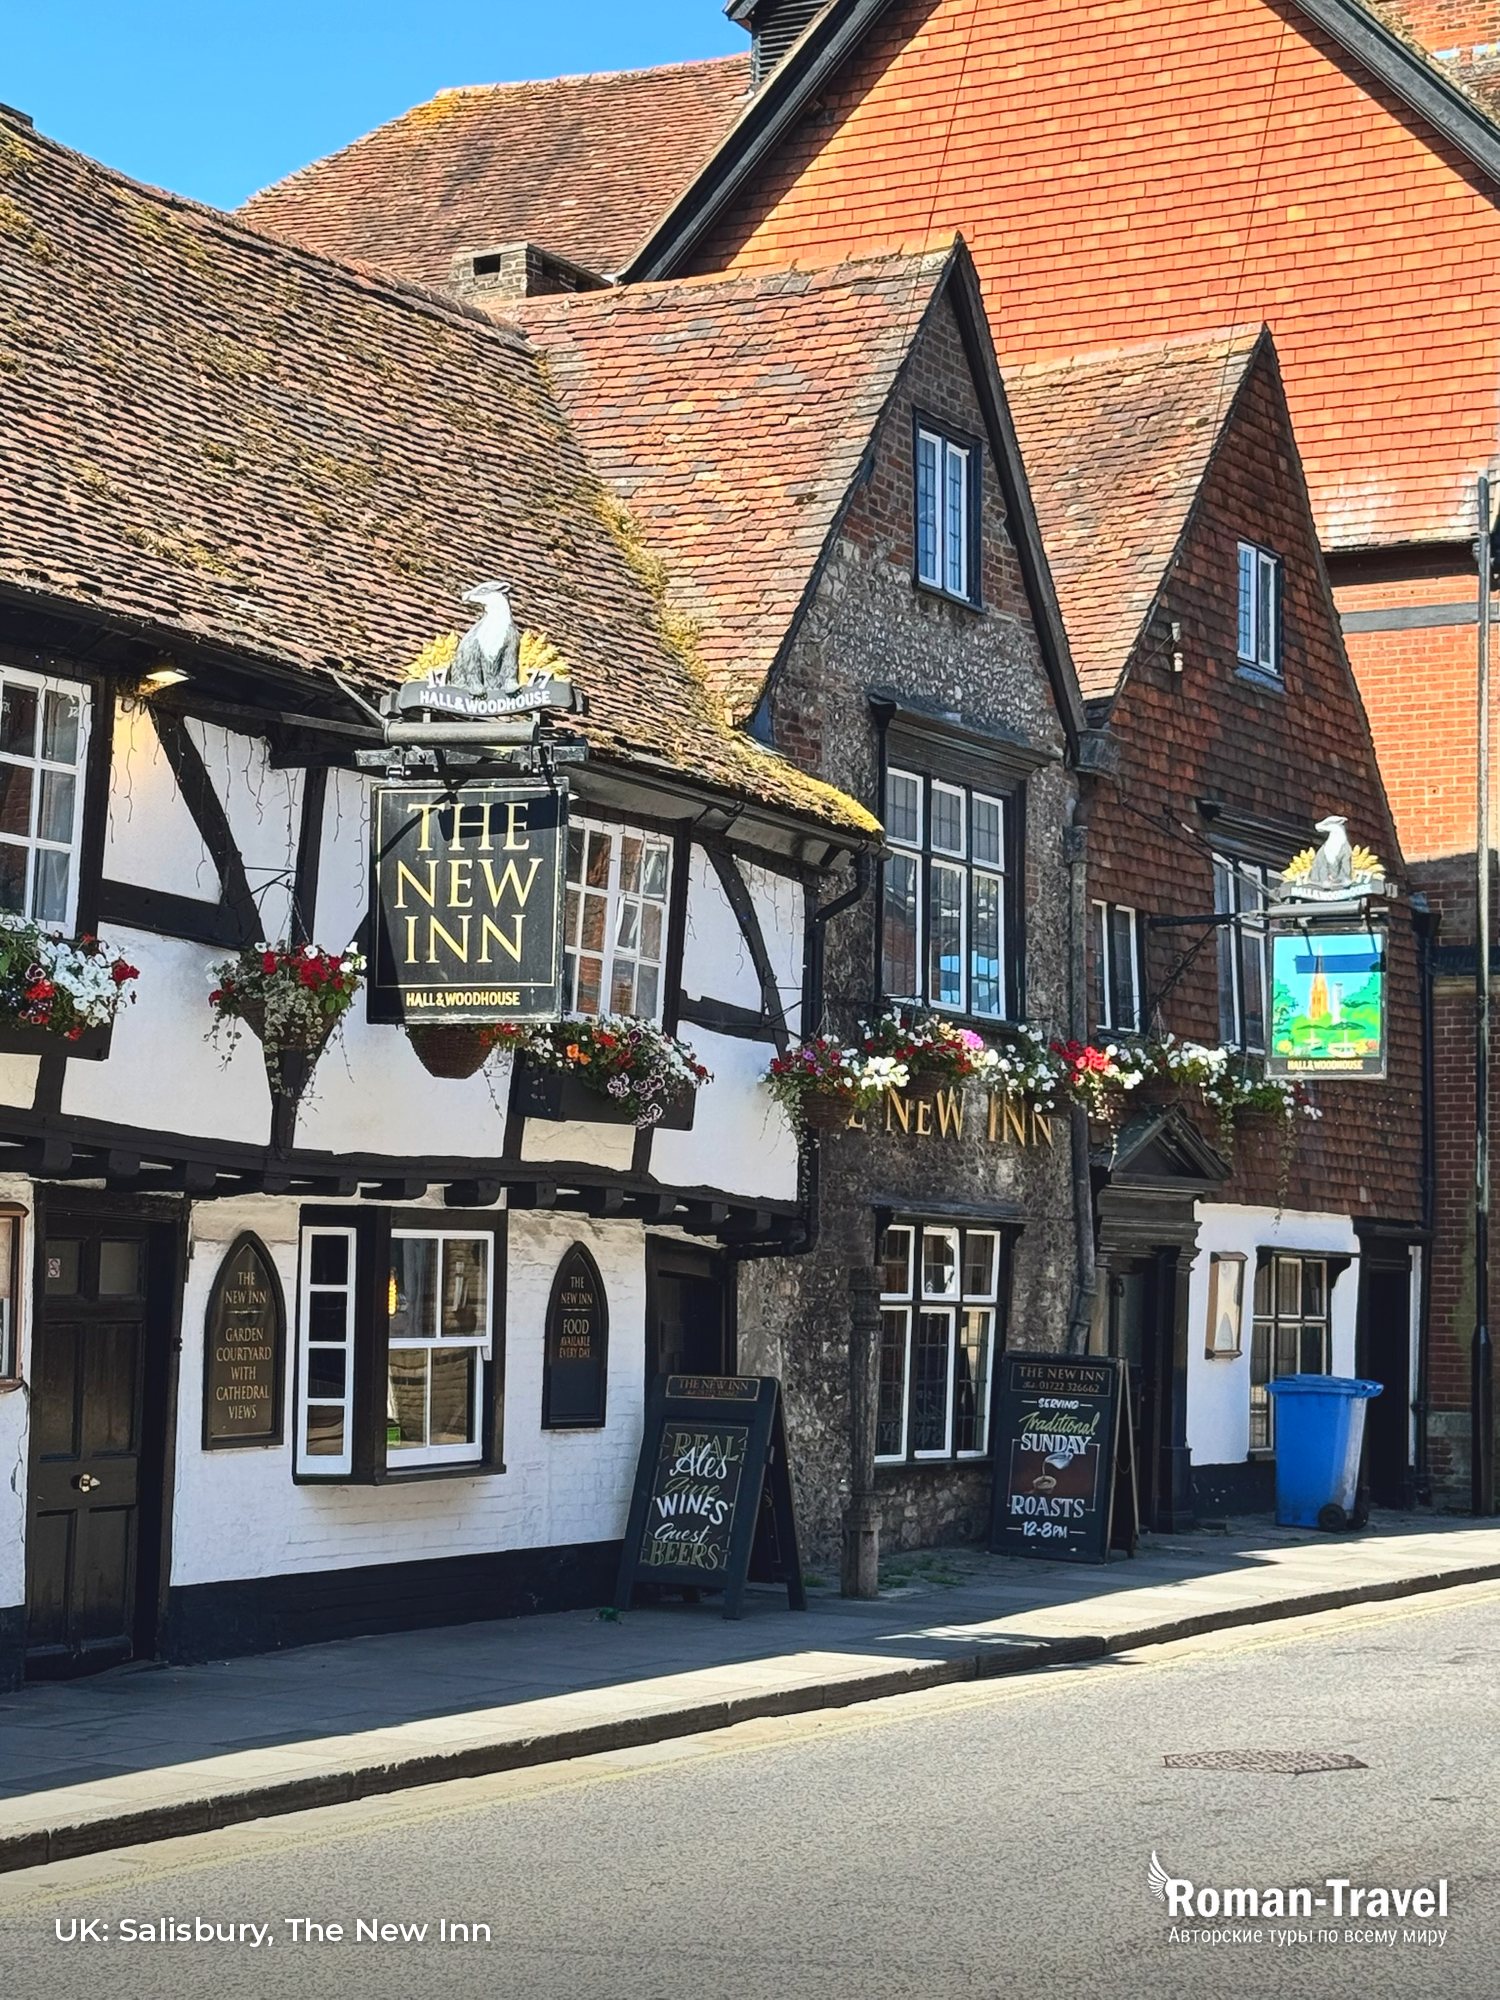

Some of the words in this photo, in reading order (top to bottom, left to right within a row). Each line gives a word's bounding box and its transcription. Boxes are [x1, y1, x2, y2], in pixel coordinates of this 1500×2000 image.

[426, 669, 446, 689] 17
[407, 802, 530, 852] THE
[394, 857, 543, 909] NEW
[403, 914, 526, 964] INN
[238, 1272, 255, 1286] THE
[570, 1276, 585, 1289] THE
[225, 1291, 247, 1304] NEW
[248, 1290, 266, 1303] INN
[561, 1293, 577, 1304] NEW
[578, 1293, 593, 1304] INN
[225, 1327, 263, 1342] GARDEN
[563, 1319, 590, 1335] FOOD
[216, 1347, 272, 1362] COURTYARD
[230, 1366, 256, 1380] WITH
[1020, 1366, 1044, 1378] THE
[1047, 1368, 1077, 1379] NEW
[1080, 1370, 1105, 1381] INN
[679, 1378, 700, 1389] THE
[701, 1379, 726, 1390] NEW
[728, 1380, 750, 1391] INN
[1039, 1381, 1064, 1391] 01722
[1067, 1383, 1100, 1393] 326662
[216, 1385, 269, 1400] CATHEDRAL
[1038, 1398, 1079, 1409] SERVING
[228, 1404, 257, 1419] VIEWS
[1019, 1412, 1100, 1436] Traditional
[672, 1432, 740, 1462] REAL
[1020, 1433, 1092, 1455] SUNDAY
[669, 1442, 728, 1479] Ales
[656, 1493, 729, 1526] WINES
[1010, 1495, 1085, 1518] ROASTS
[654, 1522, 713, 1545] Guest
[649, 1540, 721, 1570] BEERS
